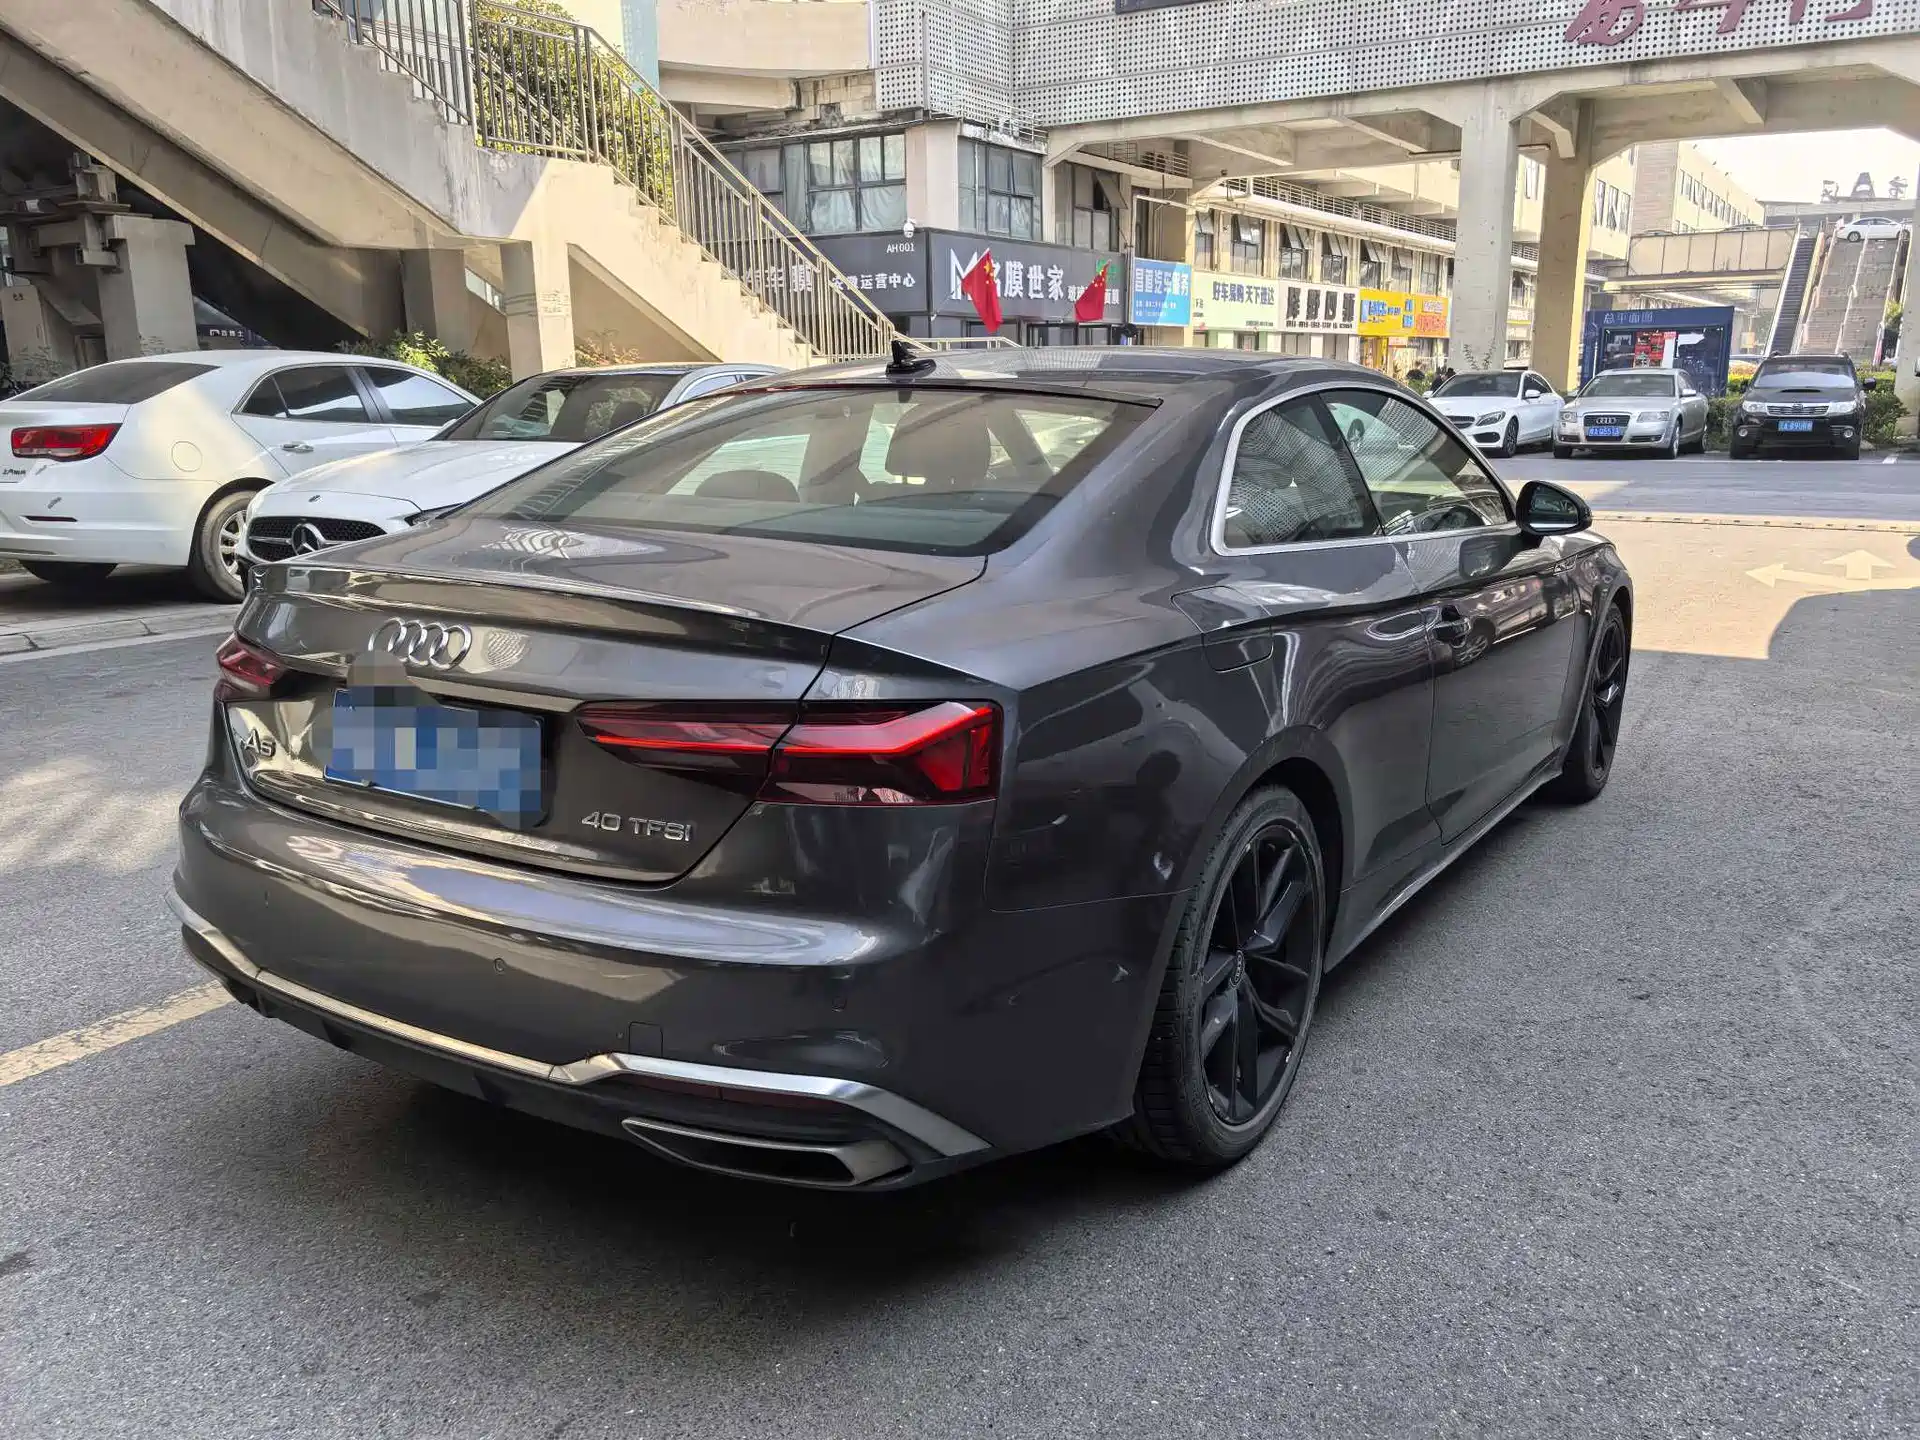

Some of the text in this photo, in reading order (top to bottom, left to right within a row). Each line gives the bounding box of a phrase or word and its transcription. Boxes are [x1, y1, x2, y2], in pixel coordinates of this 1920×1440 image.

[886, 243, 915, 254] AH001
[243, 728, 276, 757] A5
[581, 811, 692, 842] 40 TFSI
